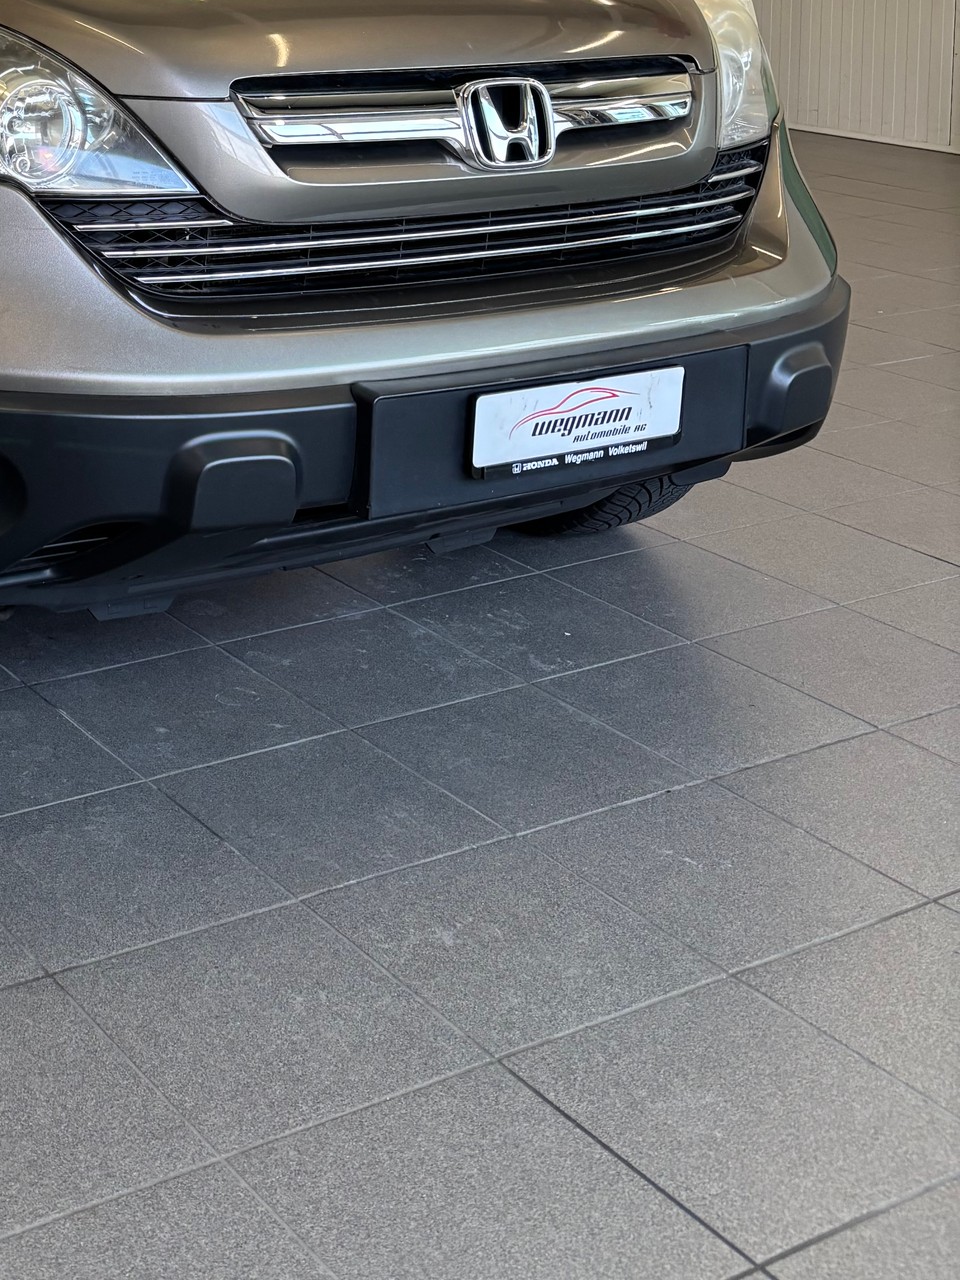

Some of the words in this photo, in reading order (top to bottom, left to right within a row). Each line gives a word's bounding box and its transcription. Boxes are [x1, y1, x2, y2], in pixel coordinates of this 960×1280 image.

[531, 406, 633, 437] wegmann
[633, 423, 647, 433] AG
[522, 458, 559, 471] HONDA
[564, 450, 604, 465] Wegmann
[608, 441, 648, 456] Volketswil
